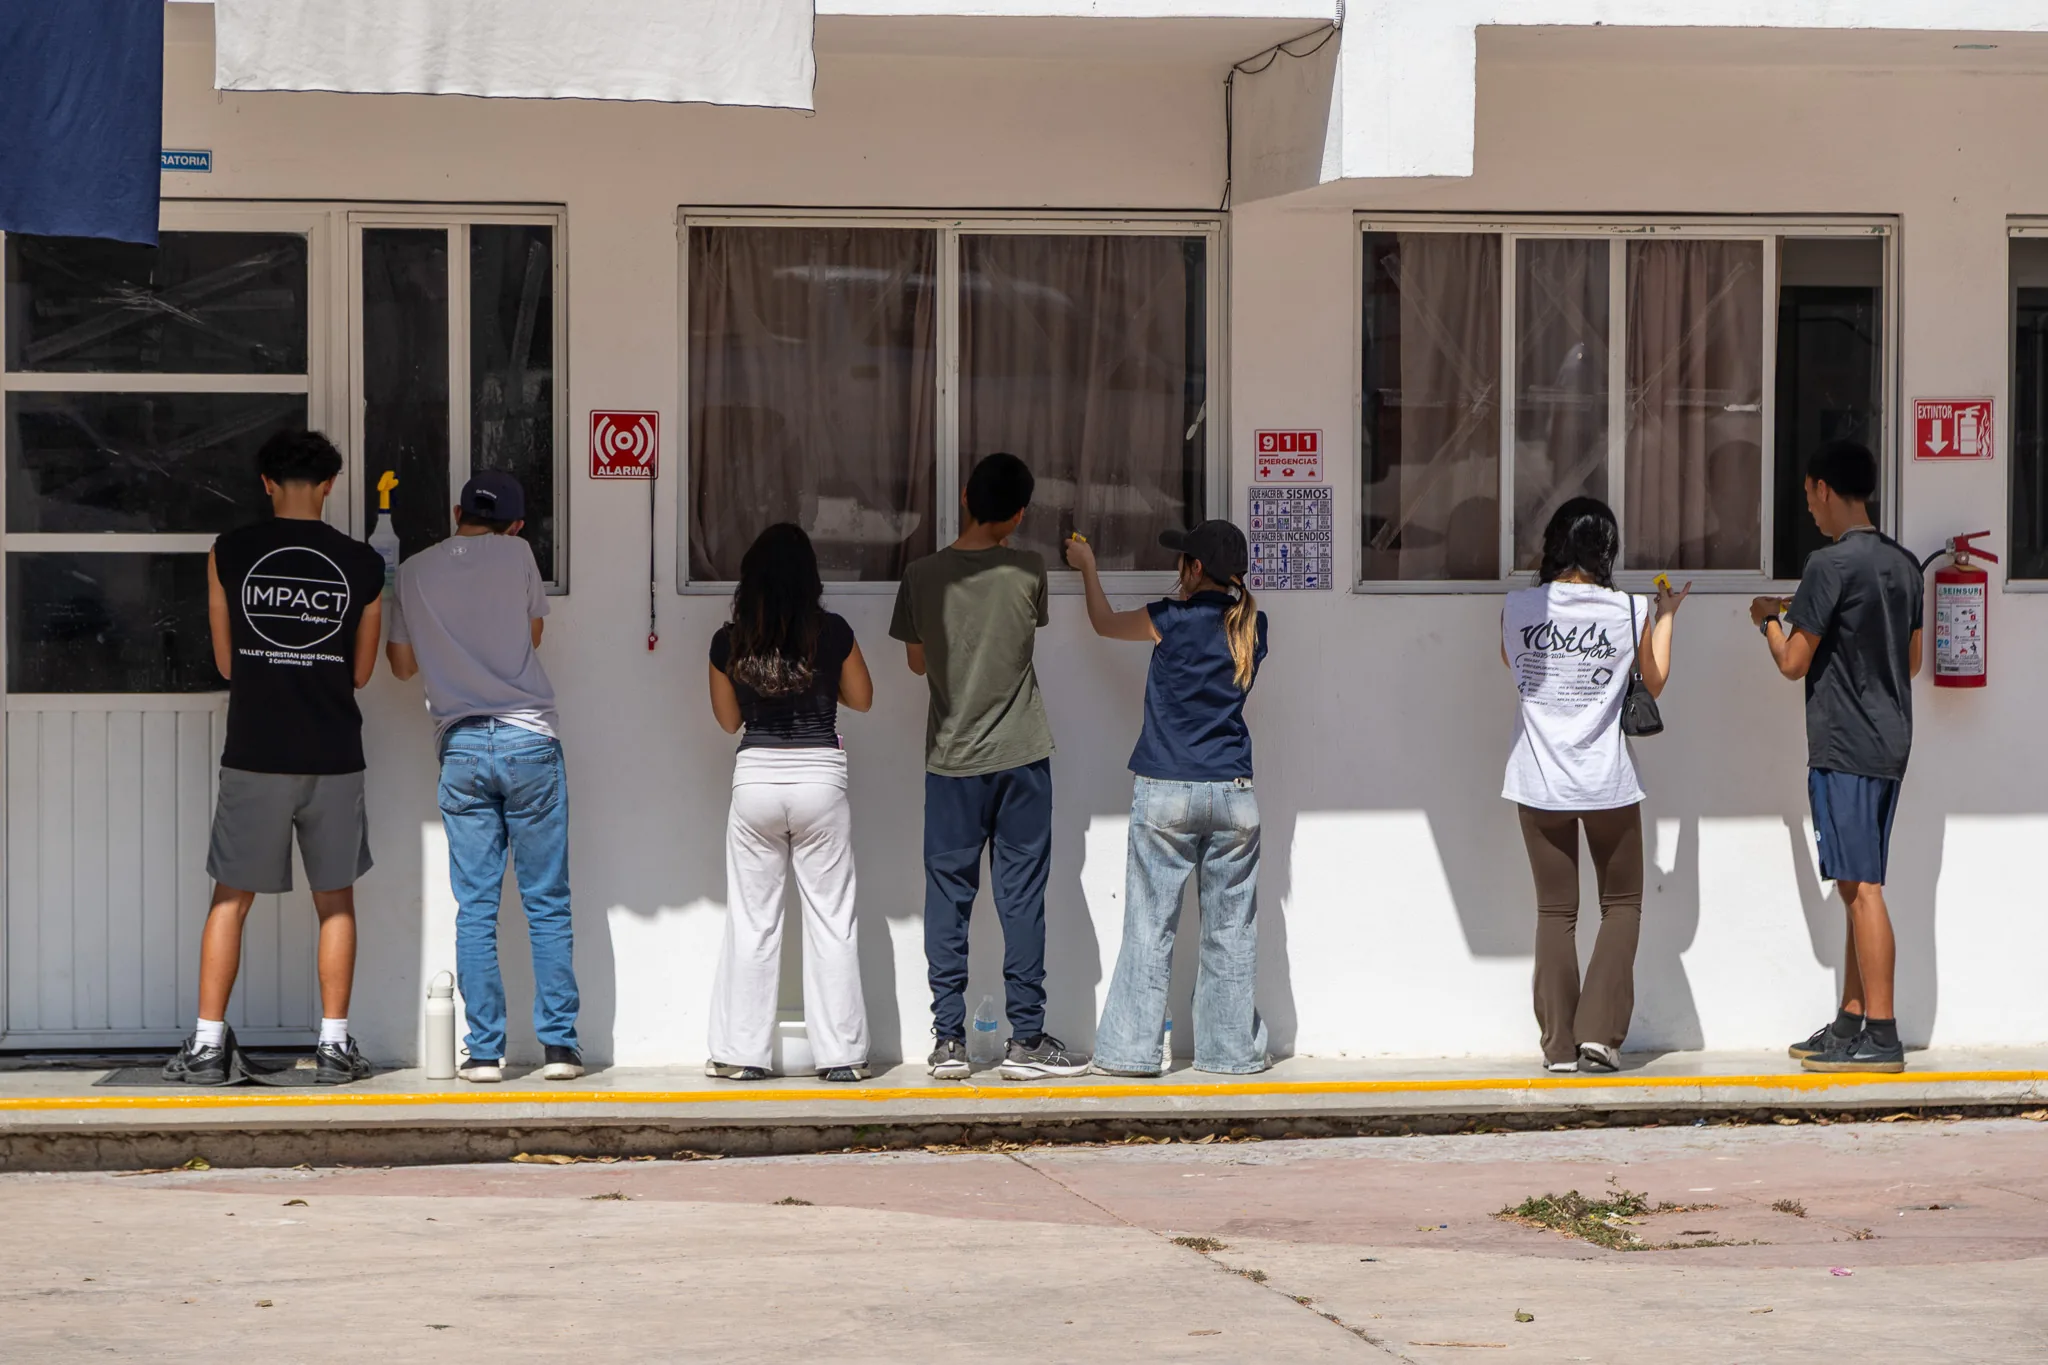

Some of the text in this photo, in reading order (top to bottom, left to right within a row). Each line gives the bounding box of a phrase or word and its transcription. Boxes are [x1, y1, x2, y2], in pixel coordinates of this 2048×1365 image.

[1918, 404, 1952, 419] EXTINTOR
[1262, 435, 1312, 450] 911
[597, 466, 651, 476] ALARMA
[1286, 489, 1328, 499] SISMOS
[1285, 532, 1330, 541] INCENDIOS
[246, 585, 347, 612] IMPACT
[239, 648, 264, 657] VALLEY
[265, 651, 300, 659] CHRISTIAN
[316, 654, 345, 663] SCHOOL
